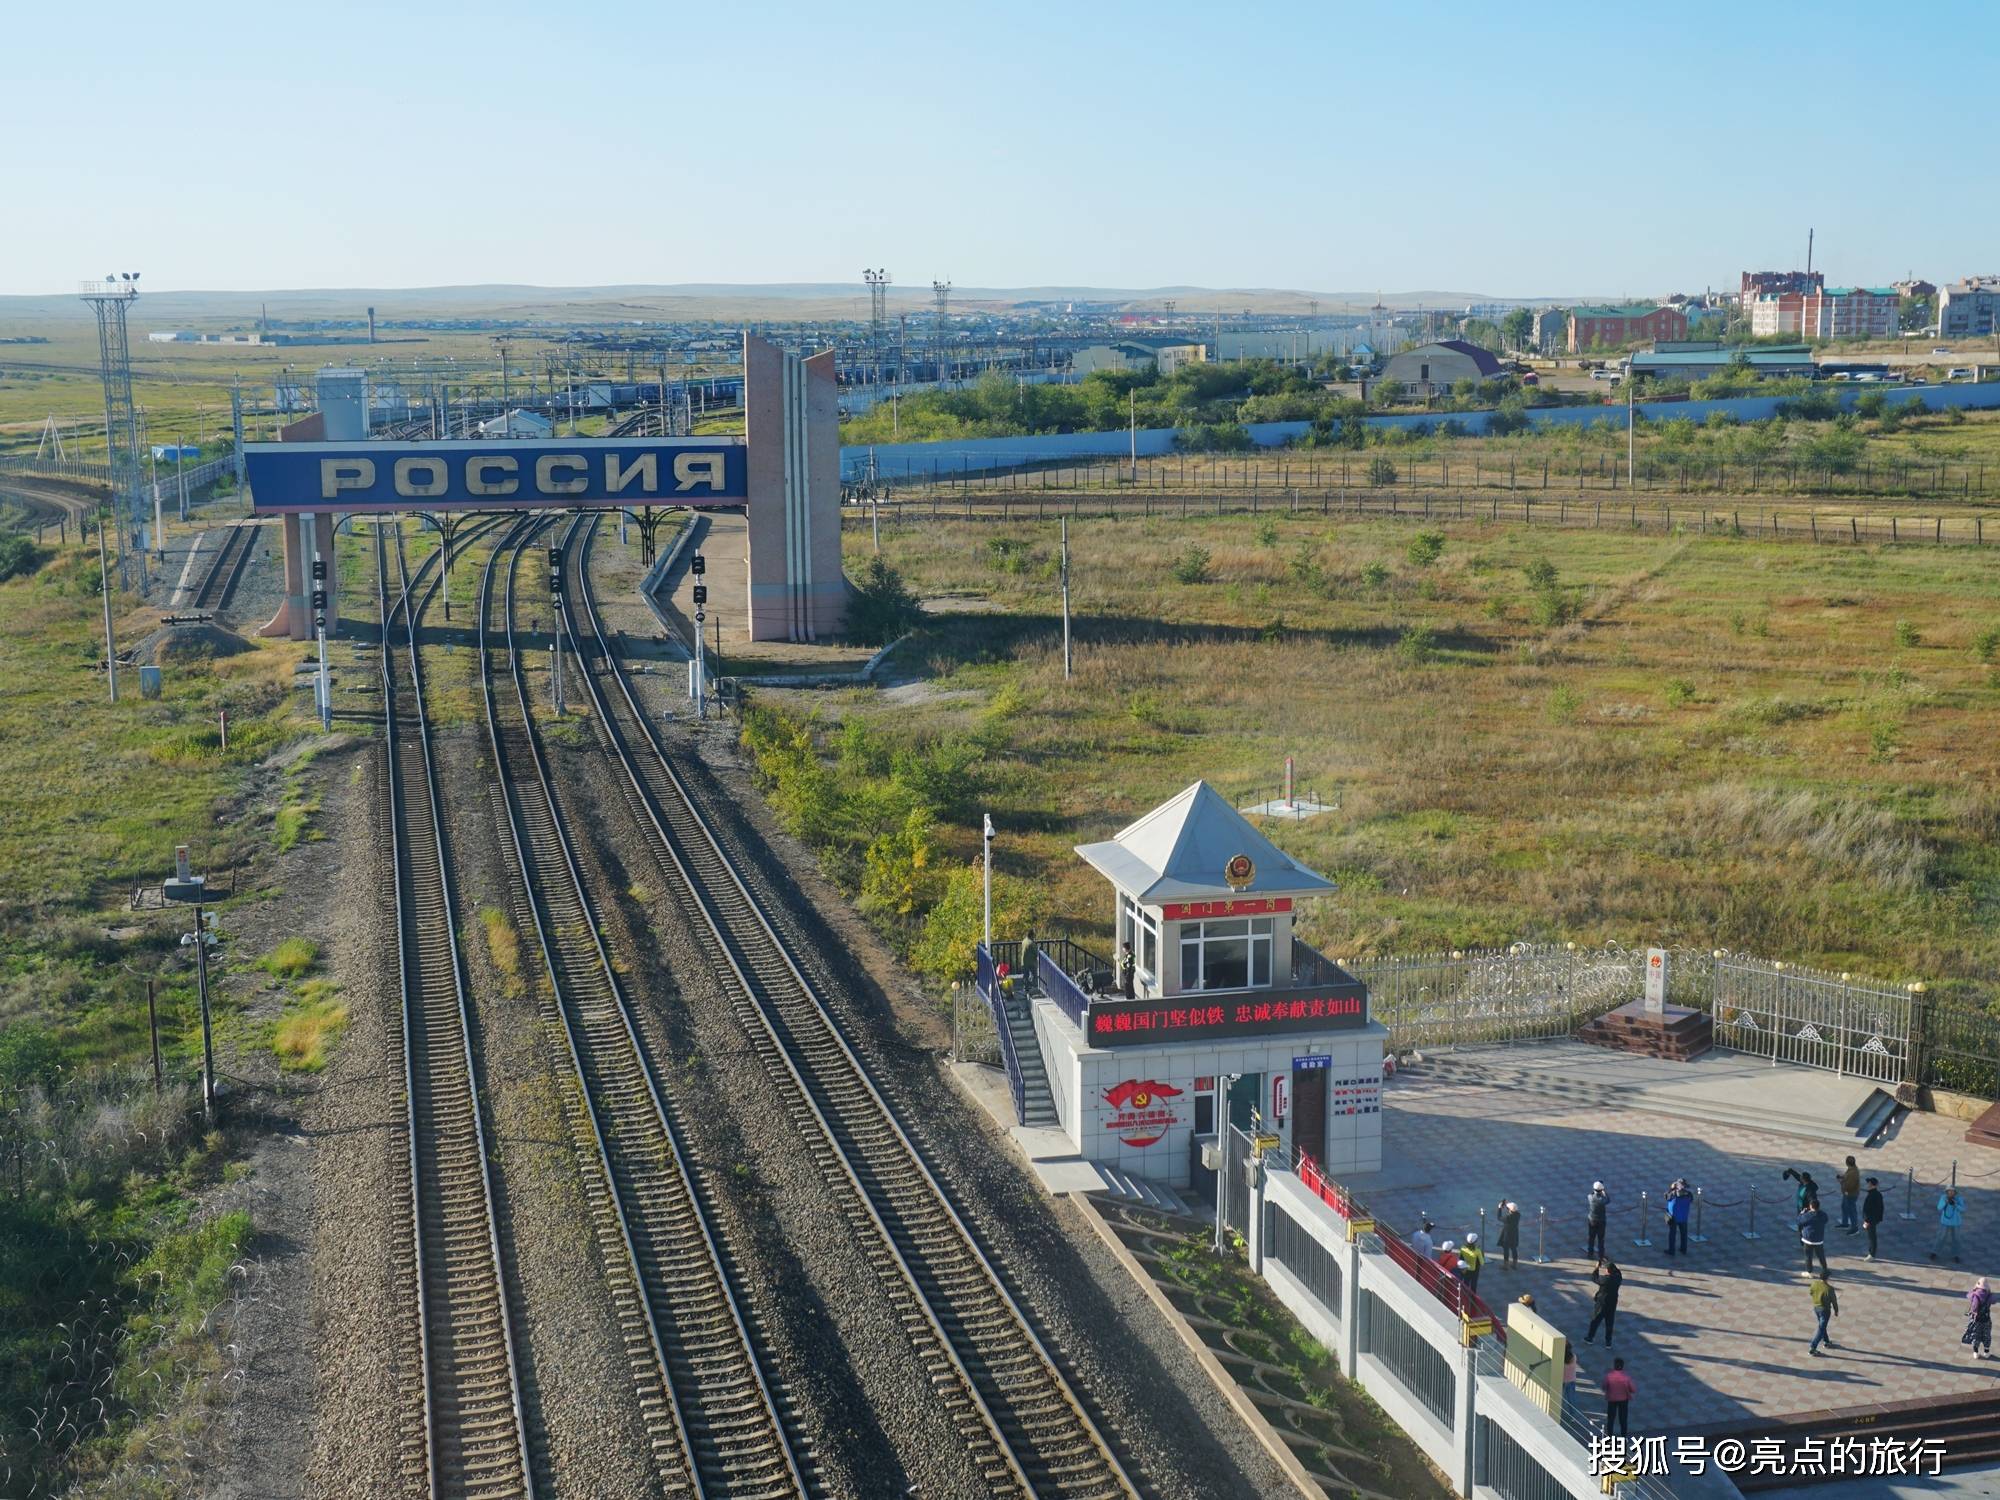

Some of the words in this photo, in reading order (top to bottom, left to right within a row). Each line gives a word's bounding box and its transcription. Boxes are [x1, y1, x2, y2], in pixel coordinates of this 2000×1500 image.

[320, 452, 726, 498] РОССИЯ
[1095, 1006, 1225, 1034] 巍巍国门坚似铁
[1235, 997, 1361, 1024] 忠诚奉献责如山
